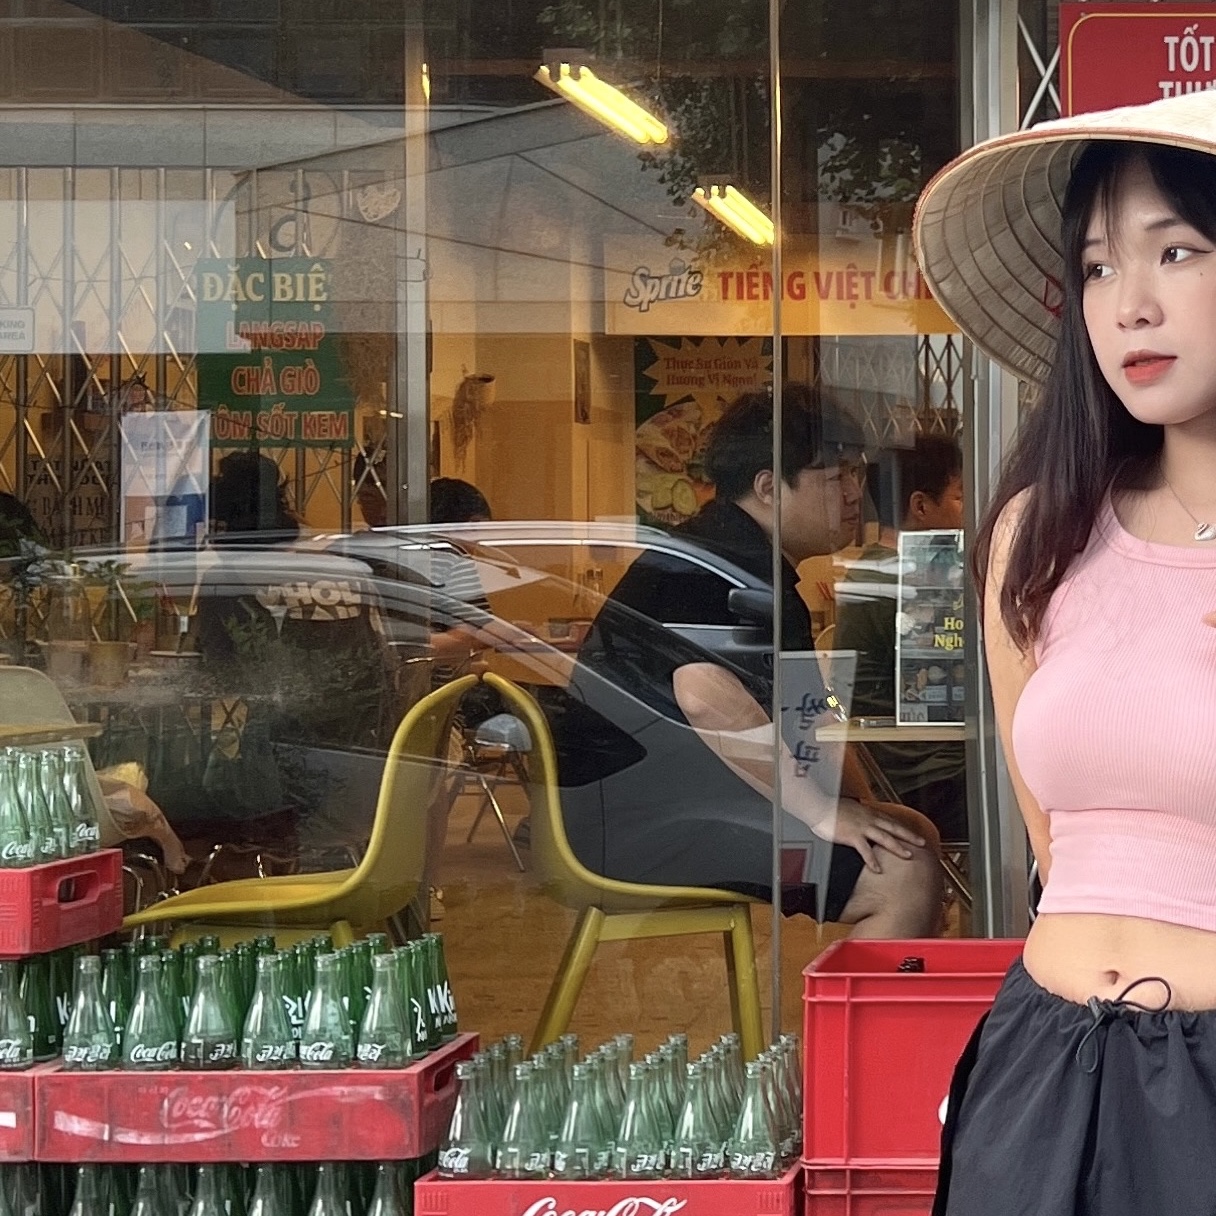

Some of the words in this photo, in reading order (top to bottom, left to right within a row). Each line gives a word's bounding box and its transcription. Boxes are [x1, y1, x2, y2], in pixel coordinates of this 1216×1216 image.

[1164, 24, 1214, 71] TỐT
[203, 263, 265, 312] ĐẶC
[623, 258, 704, 313] Sprite
[717, 254, 806, 301] TIẾNG
[814, 262, 876, 309] VIỆT
[231, 356, 277, 395] CHẢ
[280, 358, 321, 395] GIÒ
[256, 402, 298, 441] SỐT
[301, 411, 350, 441] KEM
